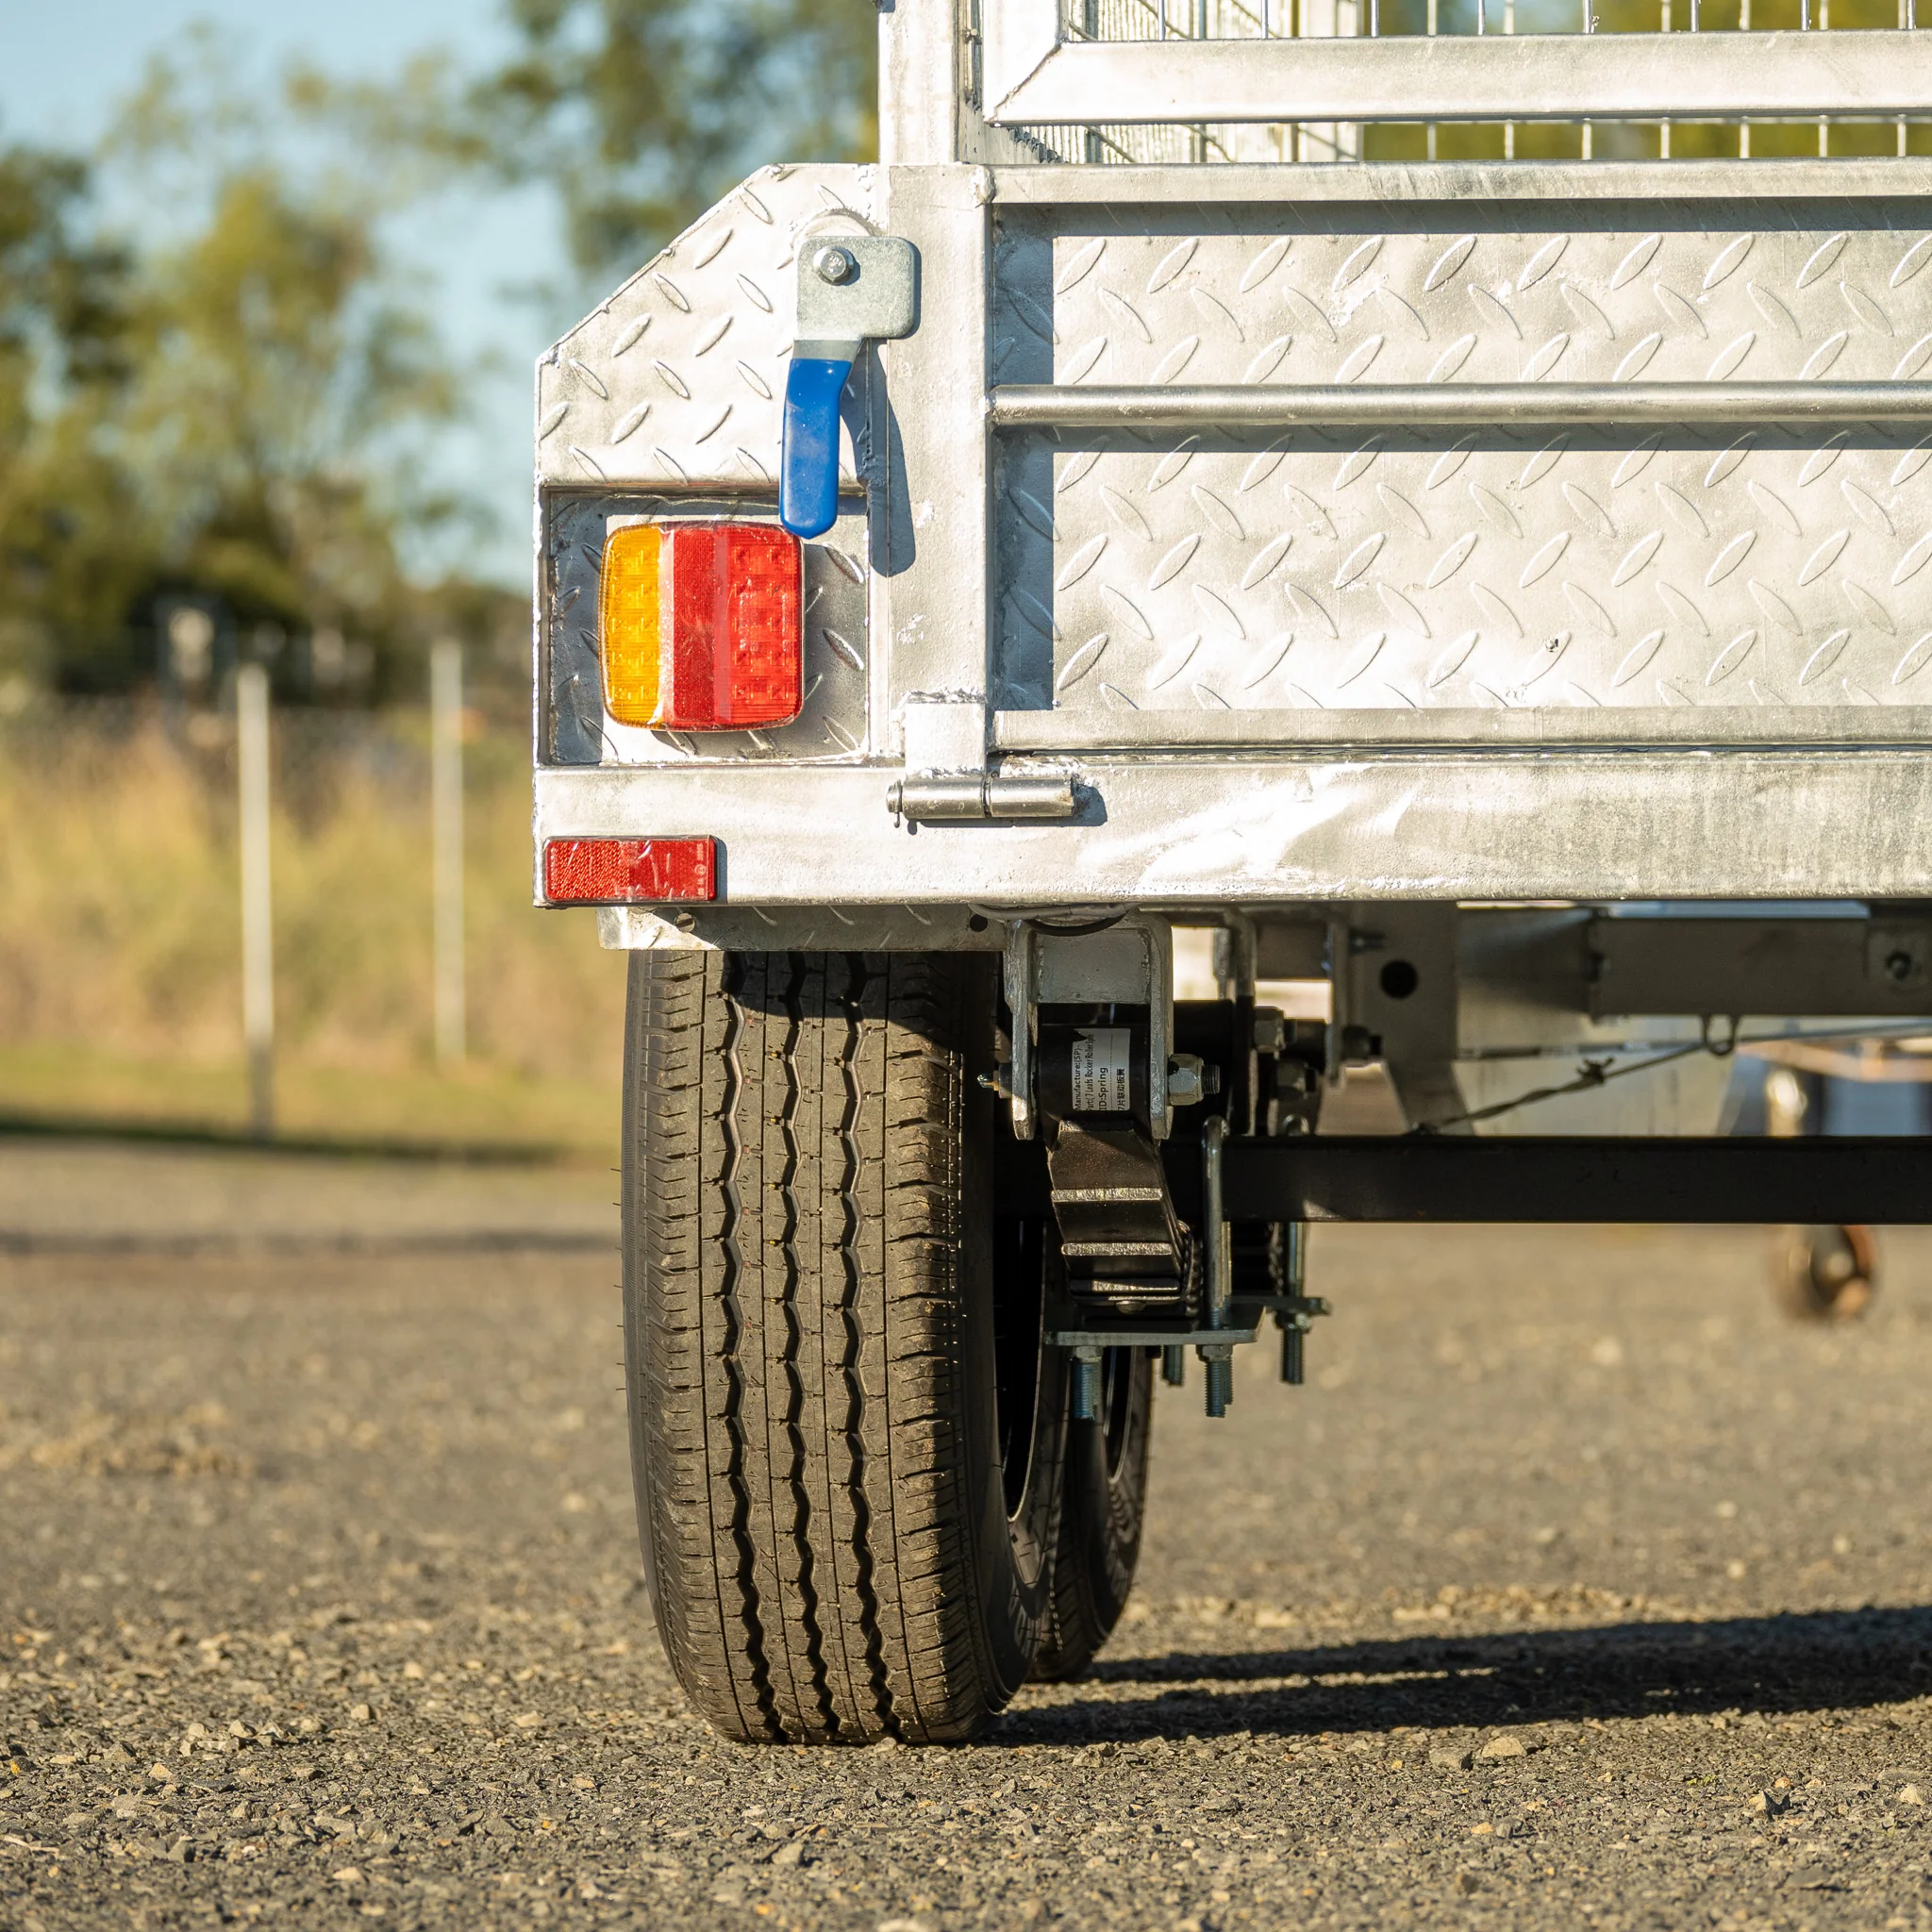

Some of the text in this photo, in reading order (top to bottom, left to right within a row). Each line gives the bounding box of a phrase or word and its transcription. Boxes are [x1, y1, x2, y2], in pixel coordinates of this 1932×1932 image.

[1084, 1059, 1093, 1078] Rocker
[1084, 1078, 1093, 1092] Leafs
[1097, 1067, 1108, 1110] ID:Spring
